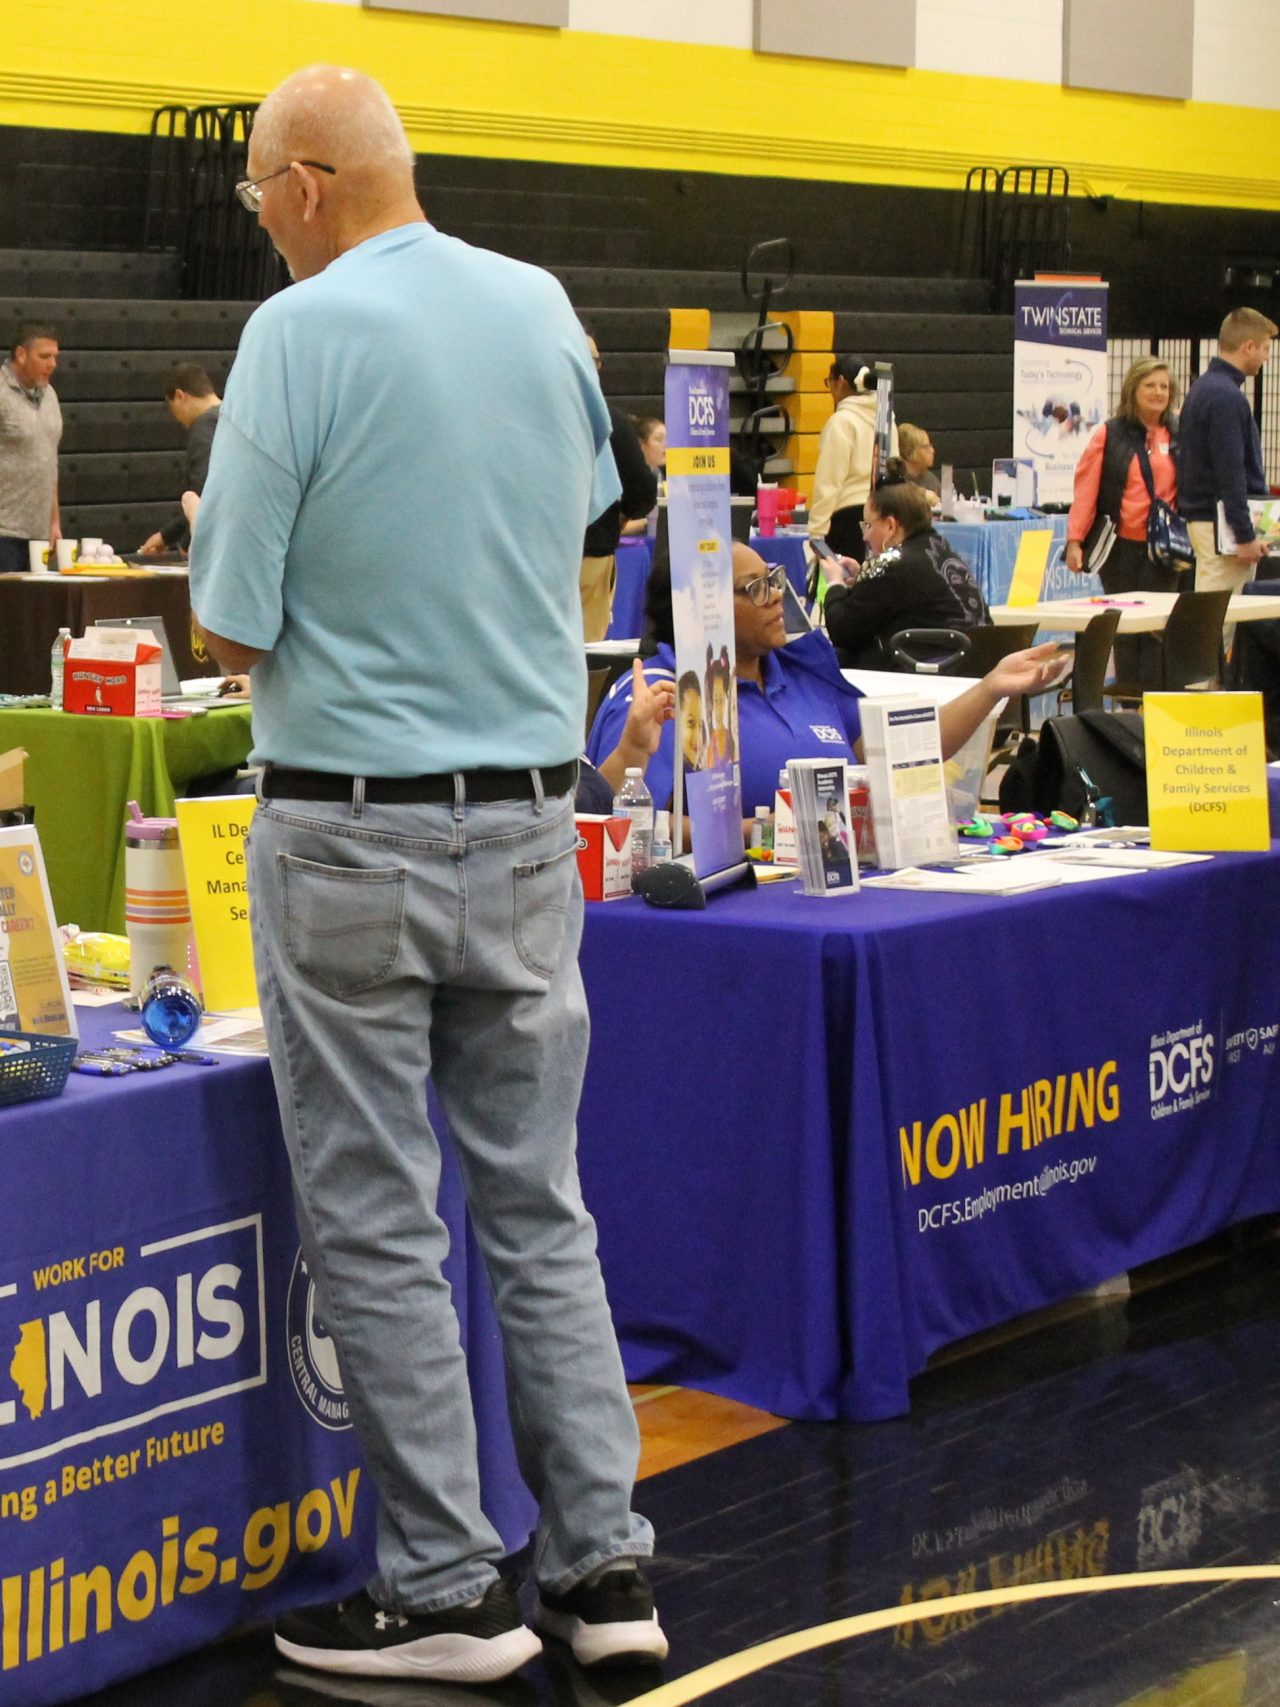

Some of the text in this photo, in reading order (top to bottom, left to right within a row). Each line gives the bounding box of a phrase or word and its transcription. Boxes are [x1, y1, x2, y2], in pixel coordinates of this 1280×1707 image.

[1021, 306, 1102, 327] TWINSTATE
[1046, 369, 1083, 381] Technology
[689, 396, 715, 426] DCFS
[693, 455, 716, 469] JOIN US
[72, 670, 104, 685] HUNGRY
[1185, 727, 1223, 738] Illinois
[1162, 745, 1248, 757] Department of
[1175, 764, 1237, 775] Children &
[1163, 783, 1251, 795] Family Services
[1189, 801, 1227, 814] (DCFS)
[212, 823, 225, 838] IL
[1, 917, 35, 934] CAREER?
[1165, 1023, 1195, 1045] Department
[1195, 1018, 1203, 1035] of
[1149, 1033, 1215, 1102] DCFS
[1150, 1101, 1172, 1121] Children
[899, 1060, 1121, 1190] NOW HIRING
[33, 1247, 125, 1291] WORK FOR
[291, 1335, 318, 1405] CENTRAL
[44, 1480, 57, 1503] a
[61, 1446, 141, 1496] Better
[146, 1421, 225, 1468] Future
